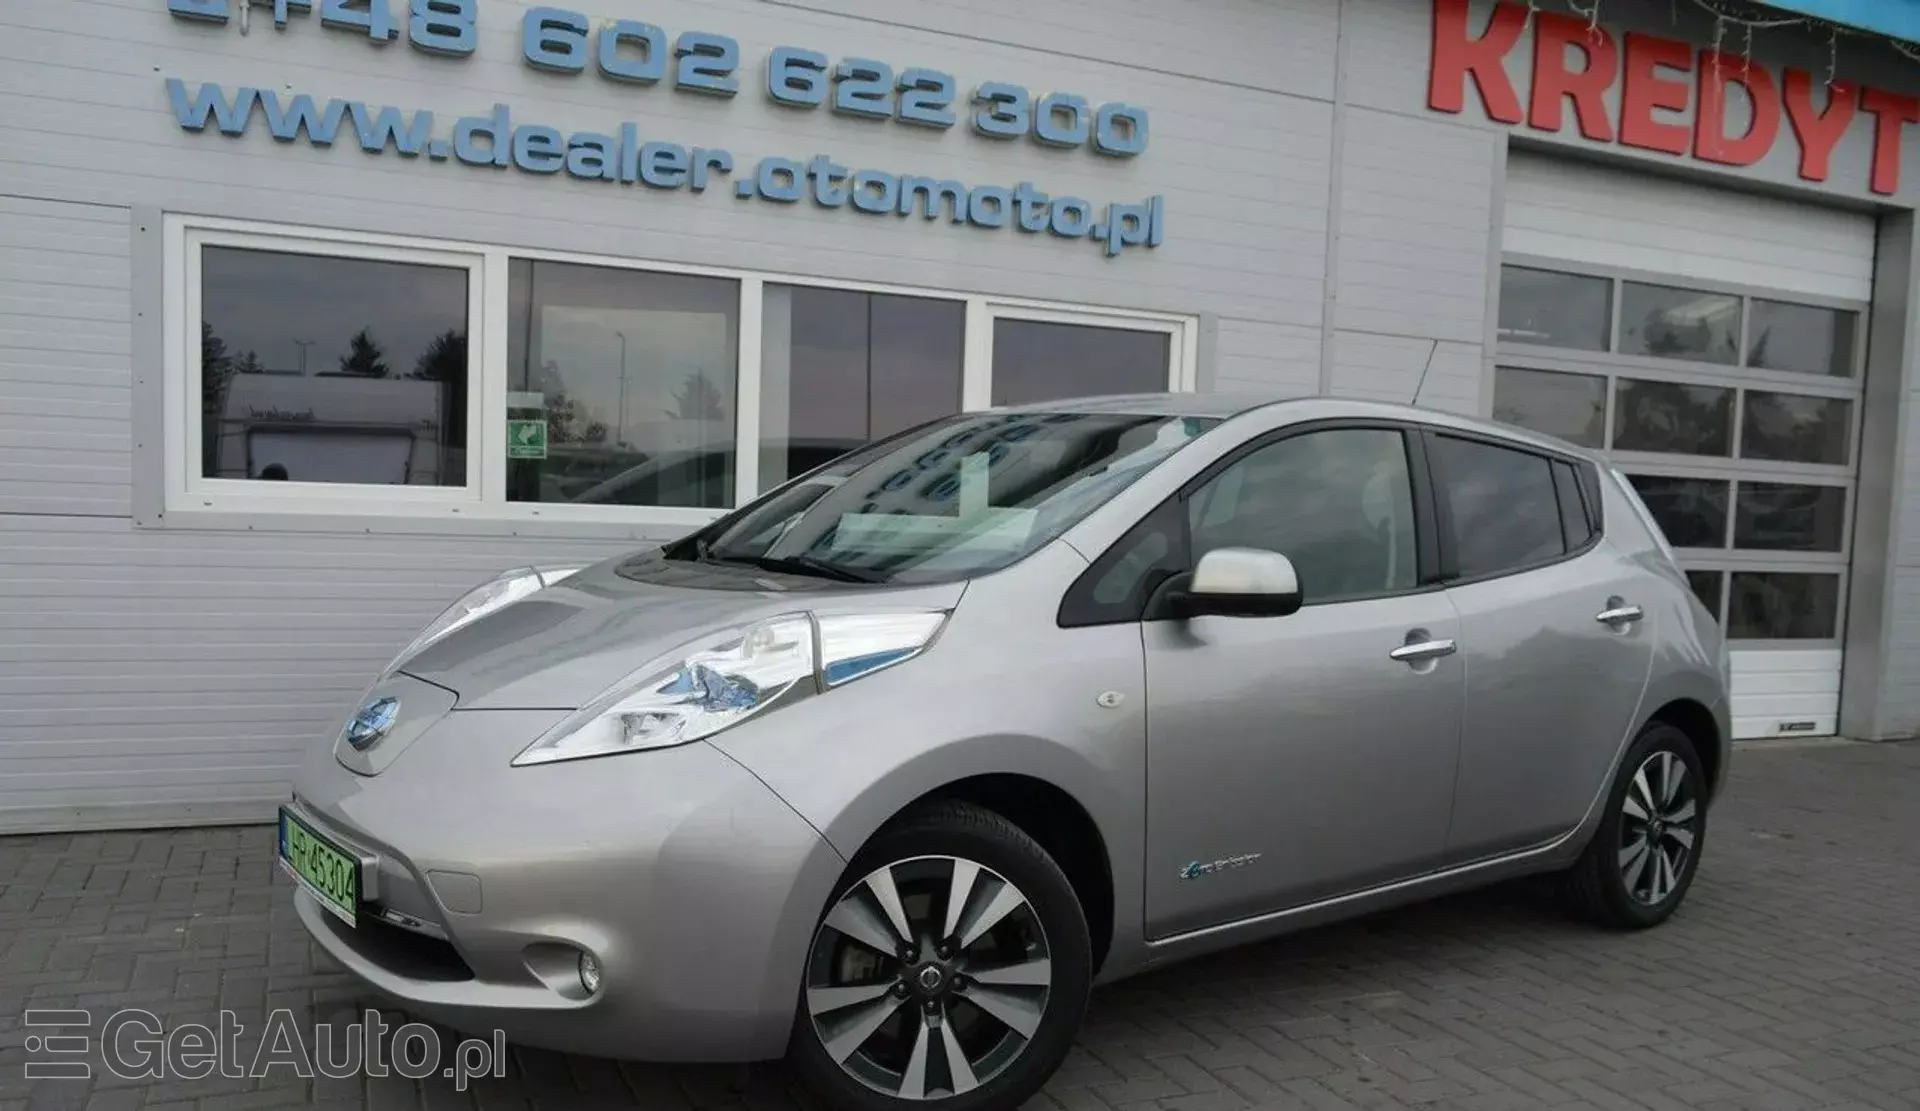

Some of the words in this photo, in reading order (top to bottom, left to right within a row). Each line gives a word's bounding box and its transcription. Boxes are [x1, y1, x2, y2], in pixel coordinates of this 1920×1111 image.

[521, 6, 741, 99] 602
[767, 45, 957, 130] 622
[971, 80, 1149, 158] 300
[1427, 0, 1920, 196] KREDYT
[165, 77, 1164, 257] www.dealer.otomoto.pl
[310, 843, 356, 913] 45304
